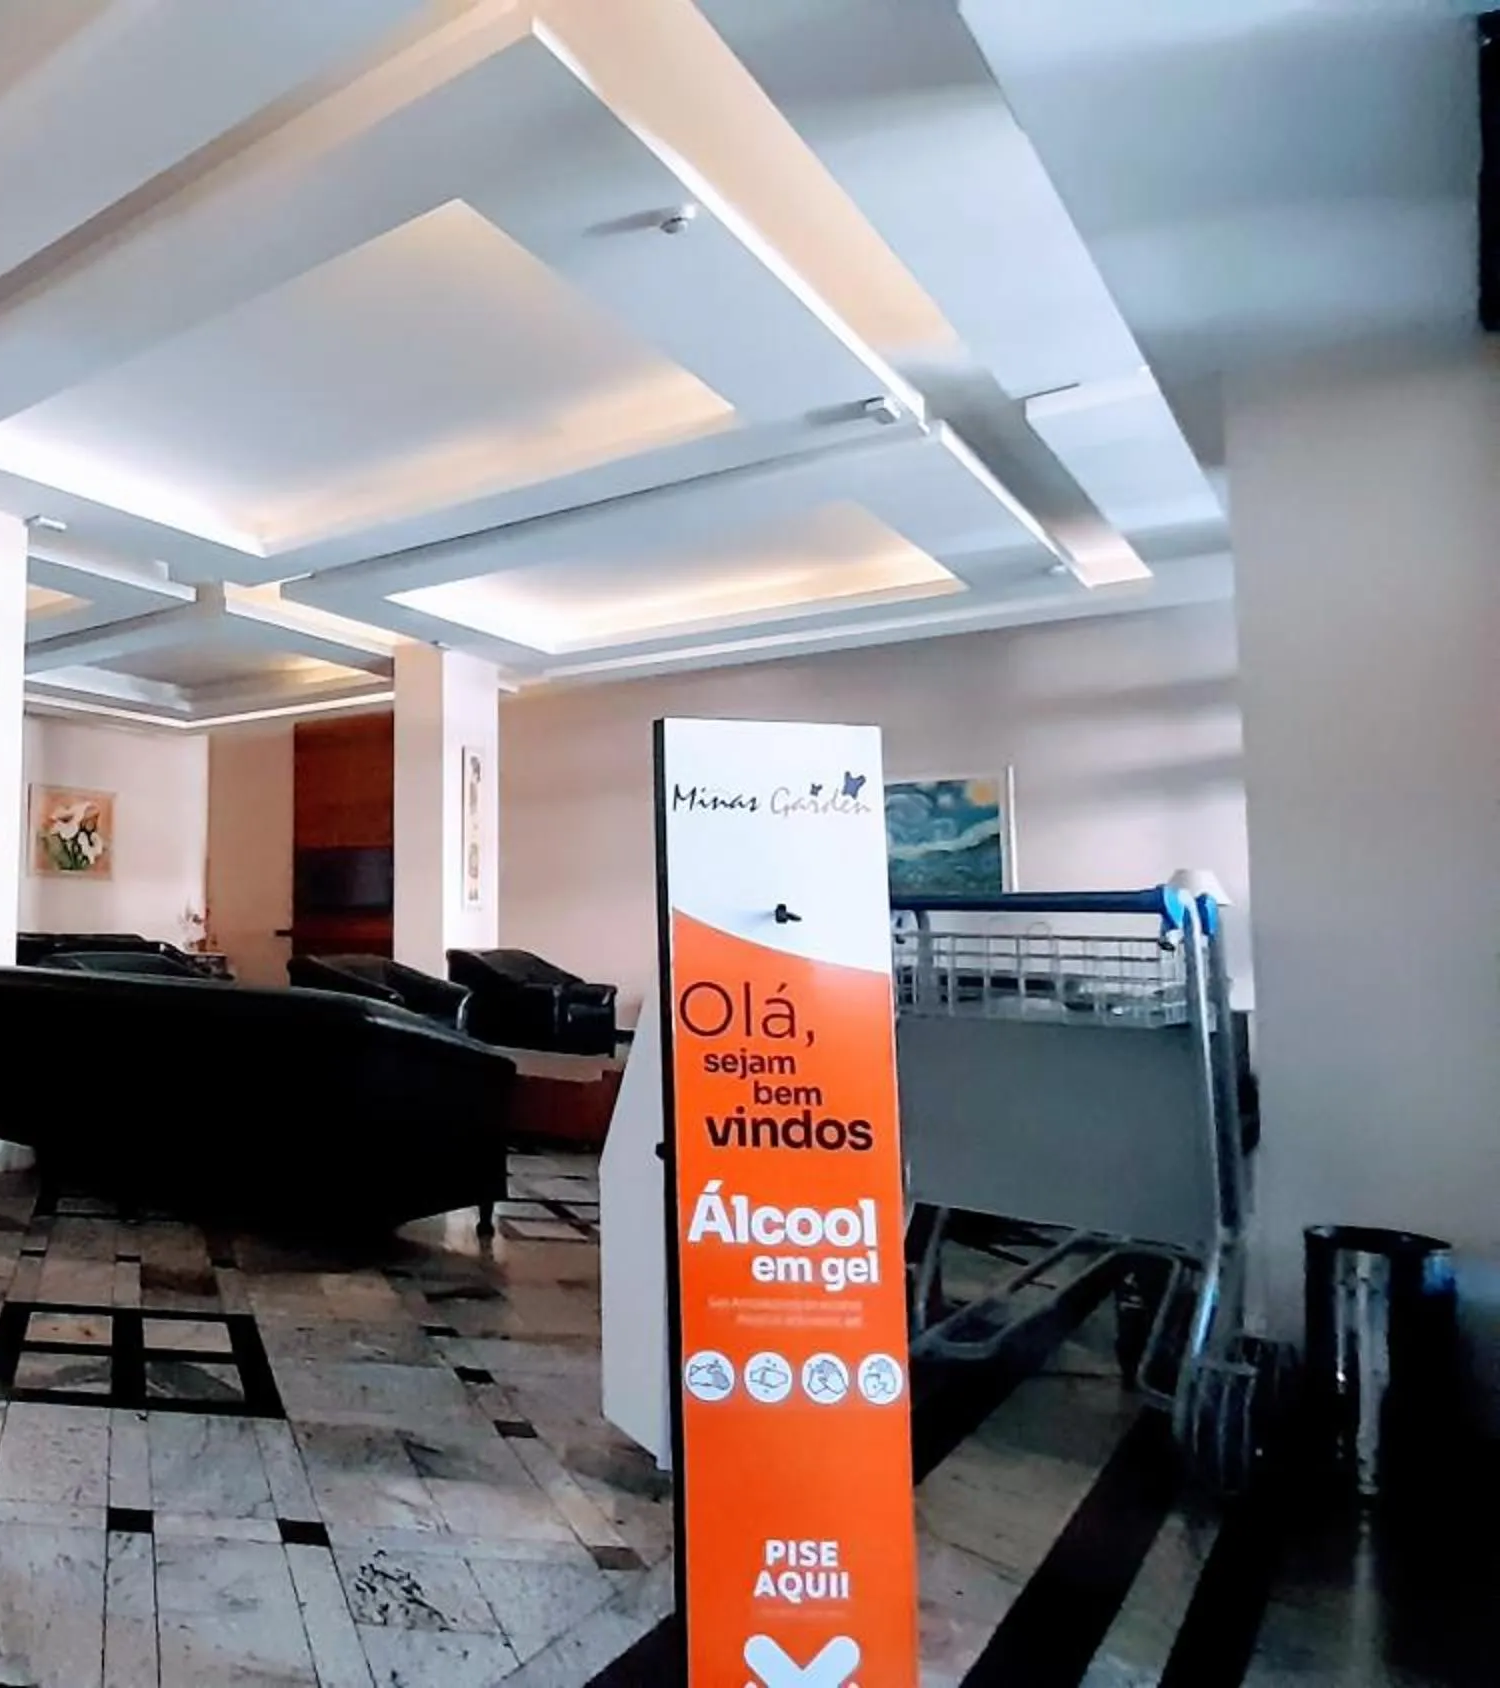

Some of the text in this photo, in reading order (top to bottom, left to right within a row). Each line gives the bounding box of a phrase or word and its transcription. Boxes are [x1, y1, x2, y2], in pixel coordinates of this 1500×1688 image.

[672, 783, 872, 817] Minas Garden
[679, 981, 815, 1047] Olá,
[703, 1048, 796, 1079] sejam
[753, 1080, 822, 1106] bem
[705, 1106, 873, 1151] vindos
[687, 1179, 878, 1247] Álcool
[752, 1250, 879, 1292] em gel
[765, 1540, 838, 1566] PISE
